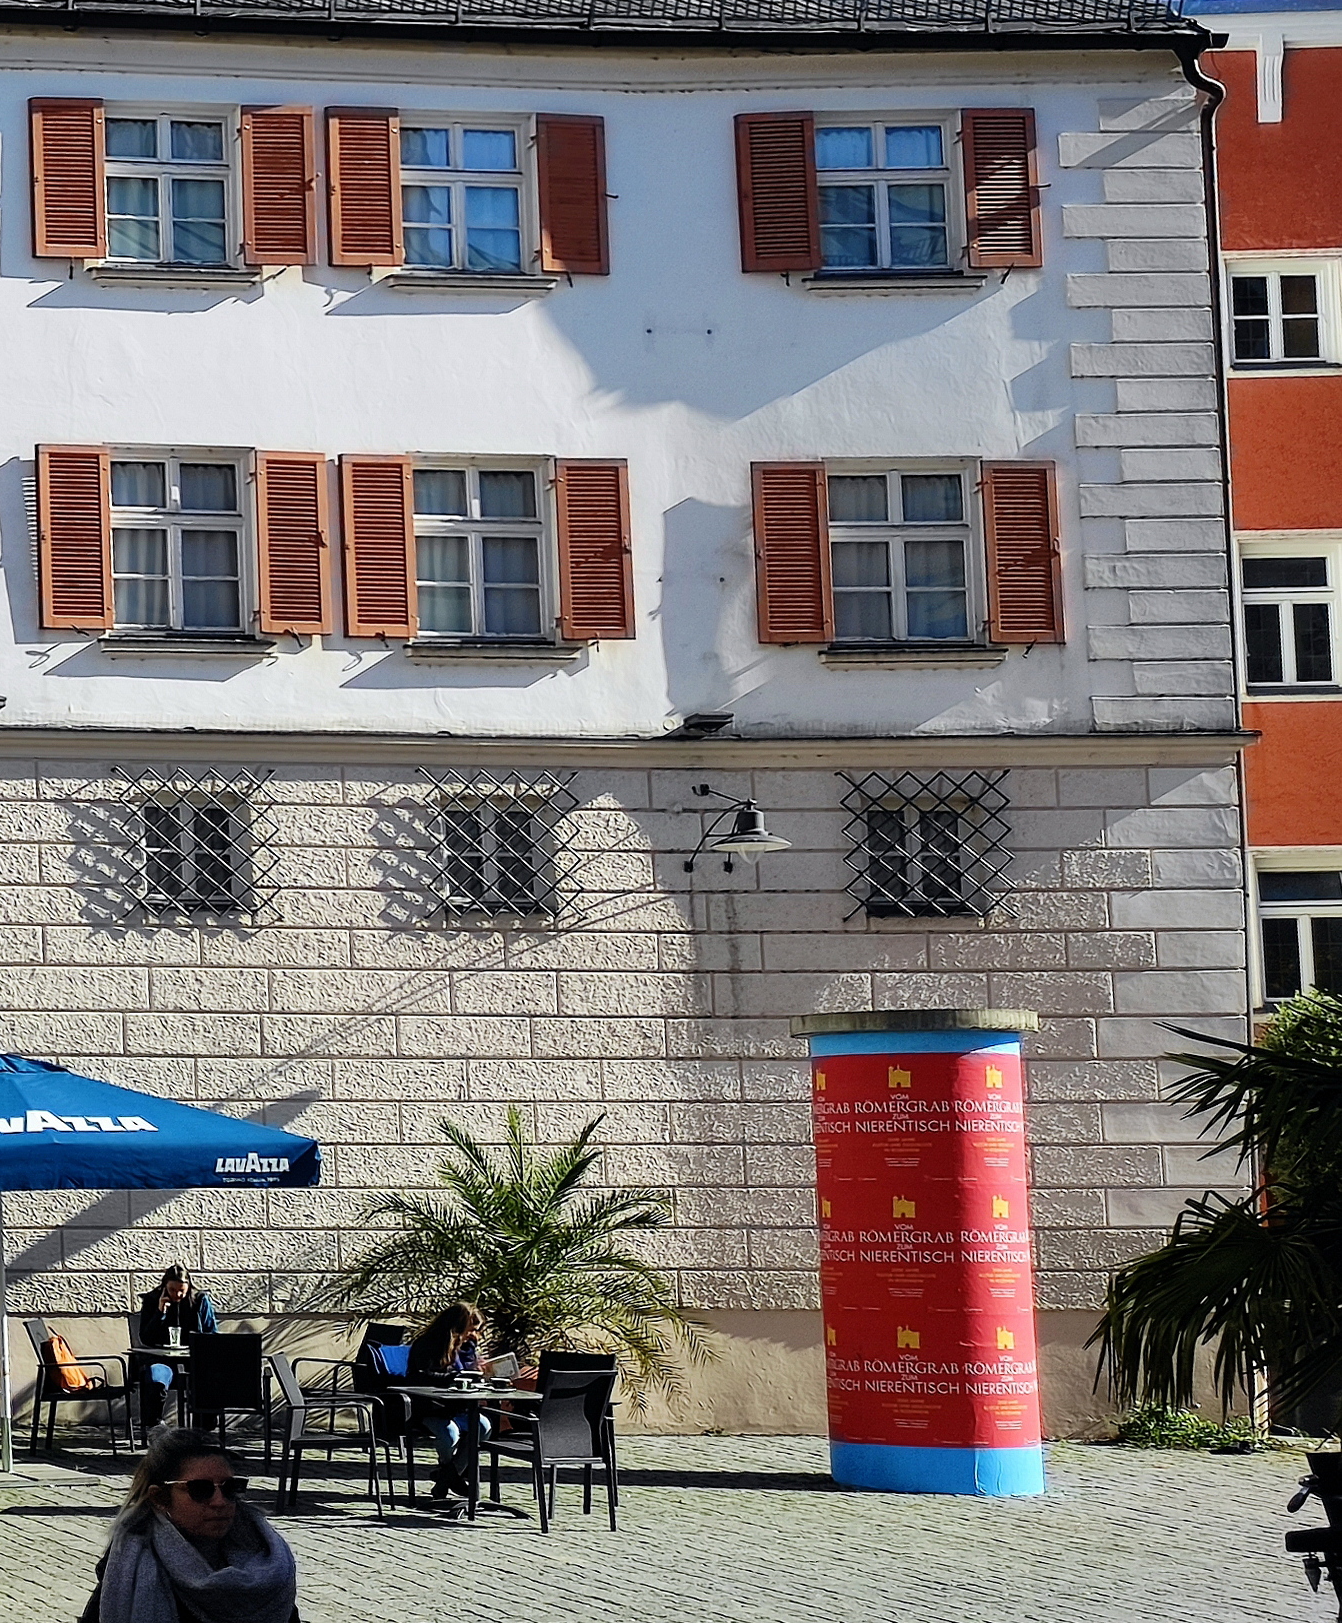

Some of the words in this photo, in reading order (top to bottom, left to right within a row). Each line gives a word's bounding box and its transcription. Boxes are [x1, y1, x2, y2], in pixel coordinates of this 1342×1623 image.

[854, 1099, 950, 1114] RÖMERGRAB
[855, 1119, 951, 1133] NIERENTISCH
[215, 1152, 290, 1173] LAVAZZA
[859, 1229, 954, 1244] RÖMERGRAB
[859, 1250, 955, 1263] NIERENTISCH
[864, 1359, 959, 1375] RÖMERGRAB
[864, 1380, 960, 1394] NIERENTISCH
